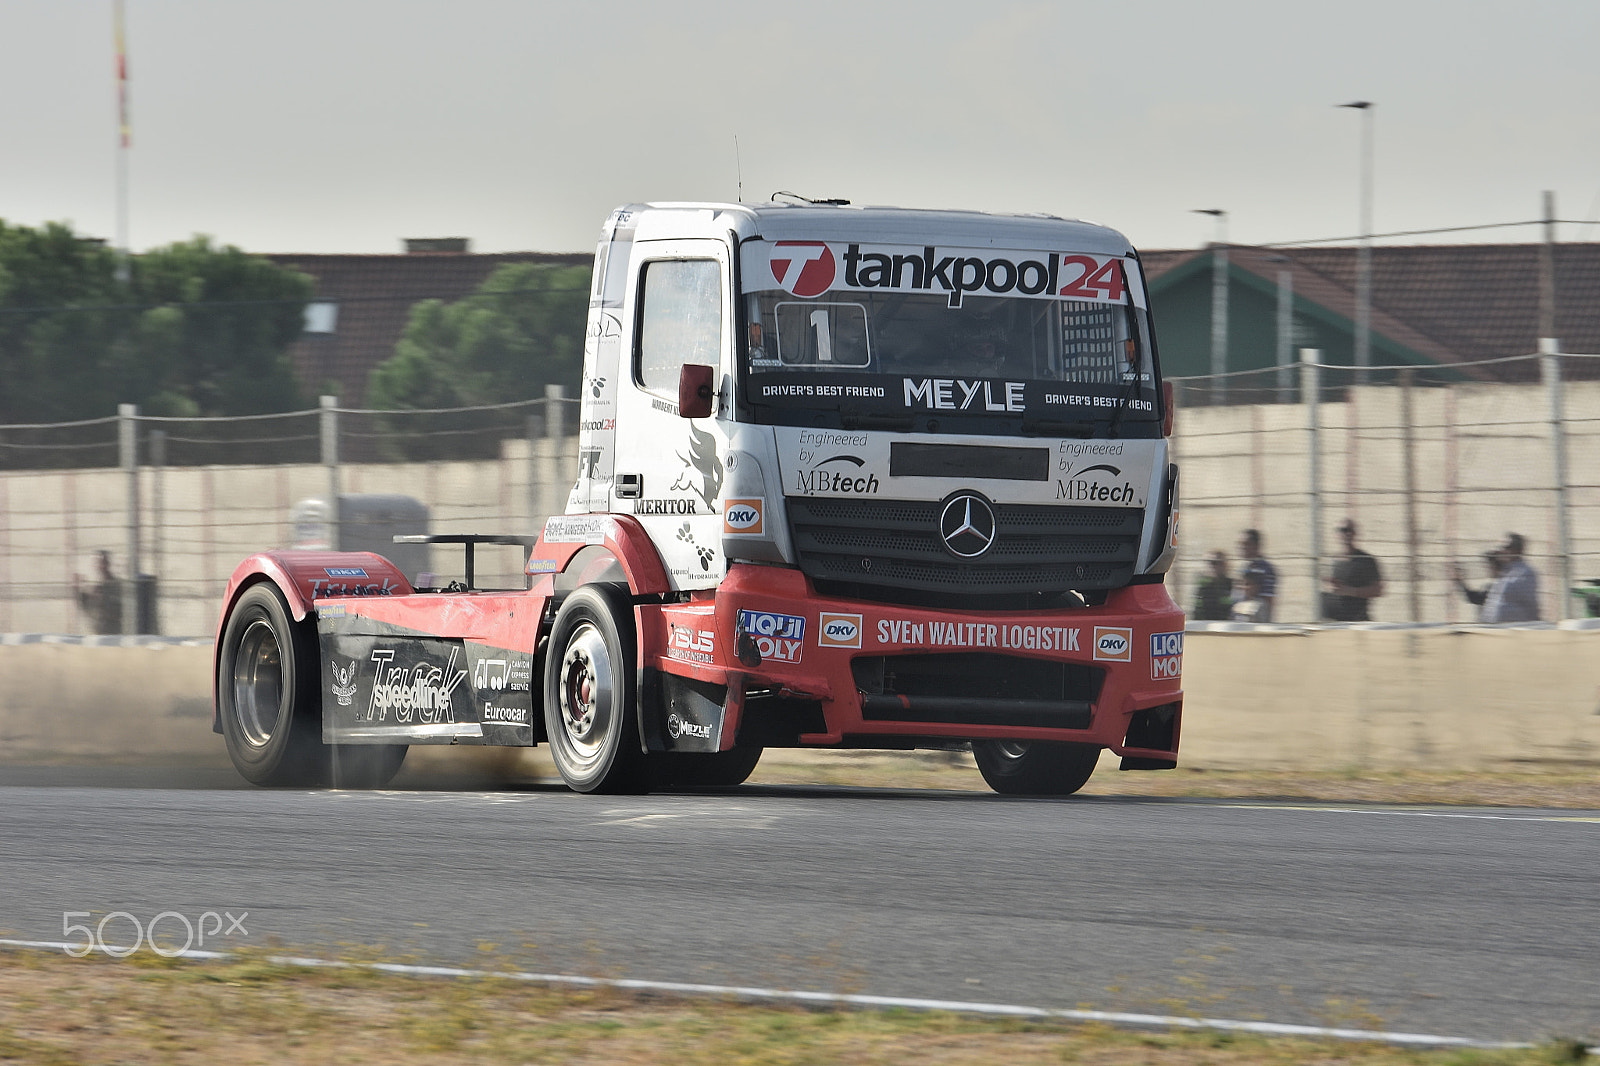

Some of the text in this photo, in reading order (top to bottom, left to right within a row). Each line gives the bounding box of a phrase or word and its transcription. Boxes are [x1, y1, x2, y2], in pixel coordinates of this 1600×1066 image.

[843, 244, 1127, 307] tankpool24
[810, 309, 832, 361] 1
[763, 386, 885, 397] DRIVER'S BEST FRIEND
[903, 378, 1026, 412] MEYLE
[1045, 394, 1091, 406] DRIVER'S
[1093, 396, 1117, 408] BEST
[800, 430, 868, 448] Engineered
[1060, 440, 1124, 457] Engineered
[799, 448, 815, 464] by
[1059, 457, 1074, 474] by
[796, 470, 879, 493] MBtech
[1056, 479, 1135, 502] MBtech
[633, 499, 697, 515] MERITOR
[728, 511, 756, 521] DKV
[740, 612, 802, 639] LIQUI
[826, 625, 855, 636] DKV
[877, 619, 1081, 652] SVEN WALTER LOGISTIK
[748, 636, 801, 660] OLY
[1100, 639, 1126, 650] DKV
[1153, 634, 1184, 655] LIQU
[1153, 656, 1182, 677] MOL
[366, 646, 468, 723] Truck
[484, 702, 527, 721] Europcar
